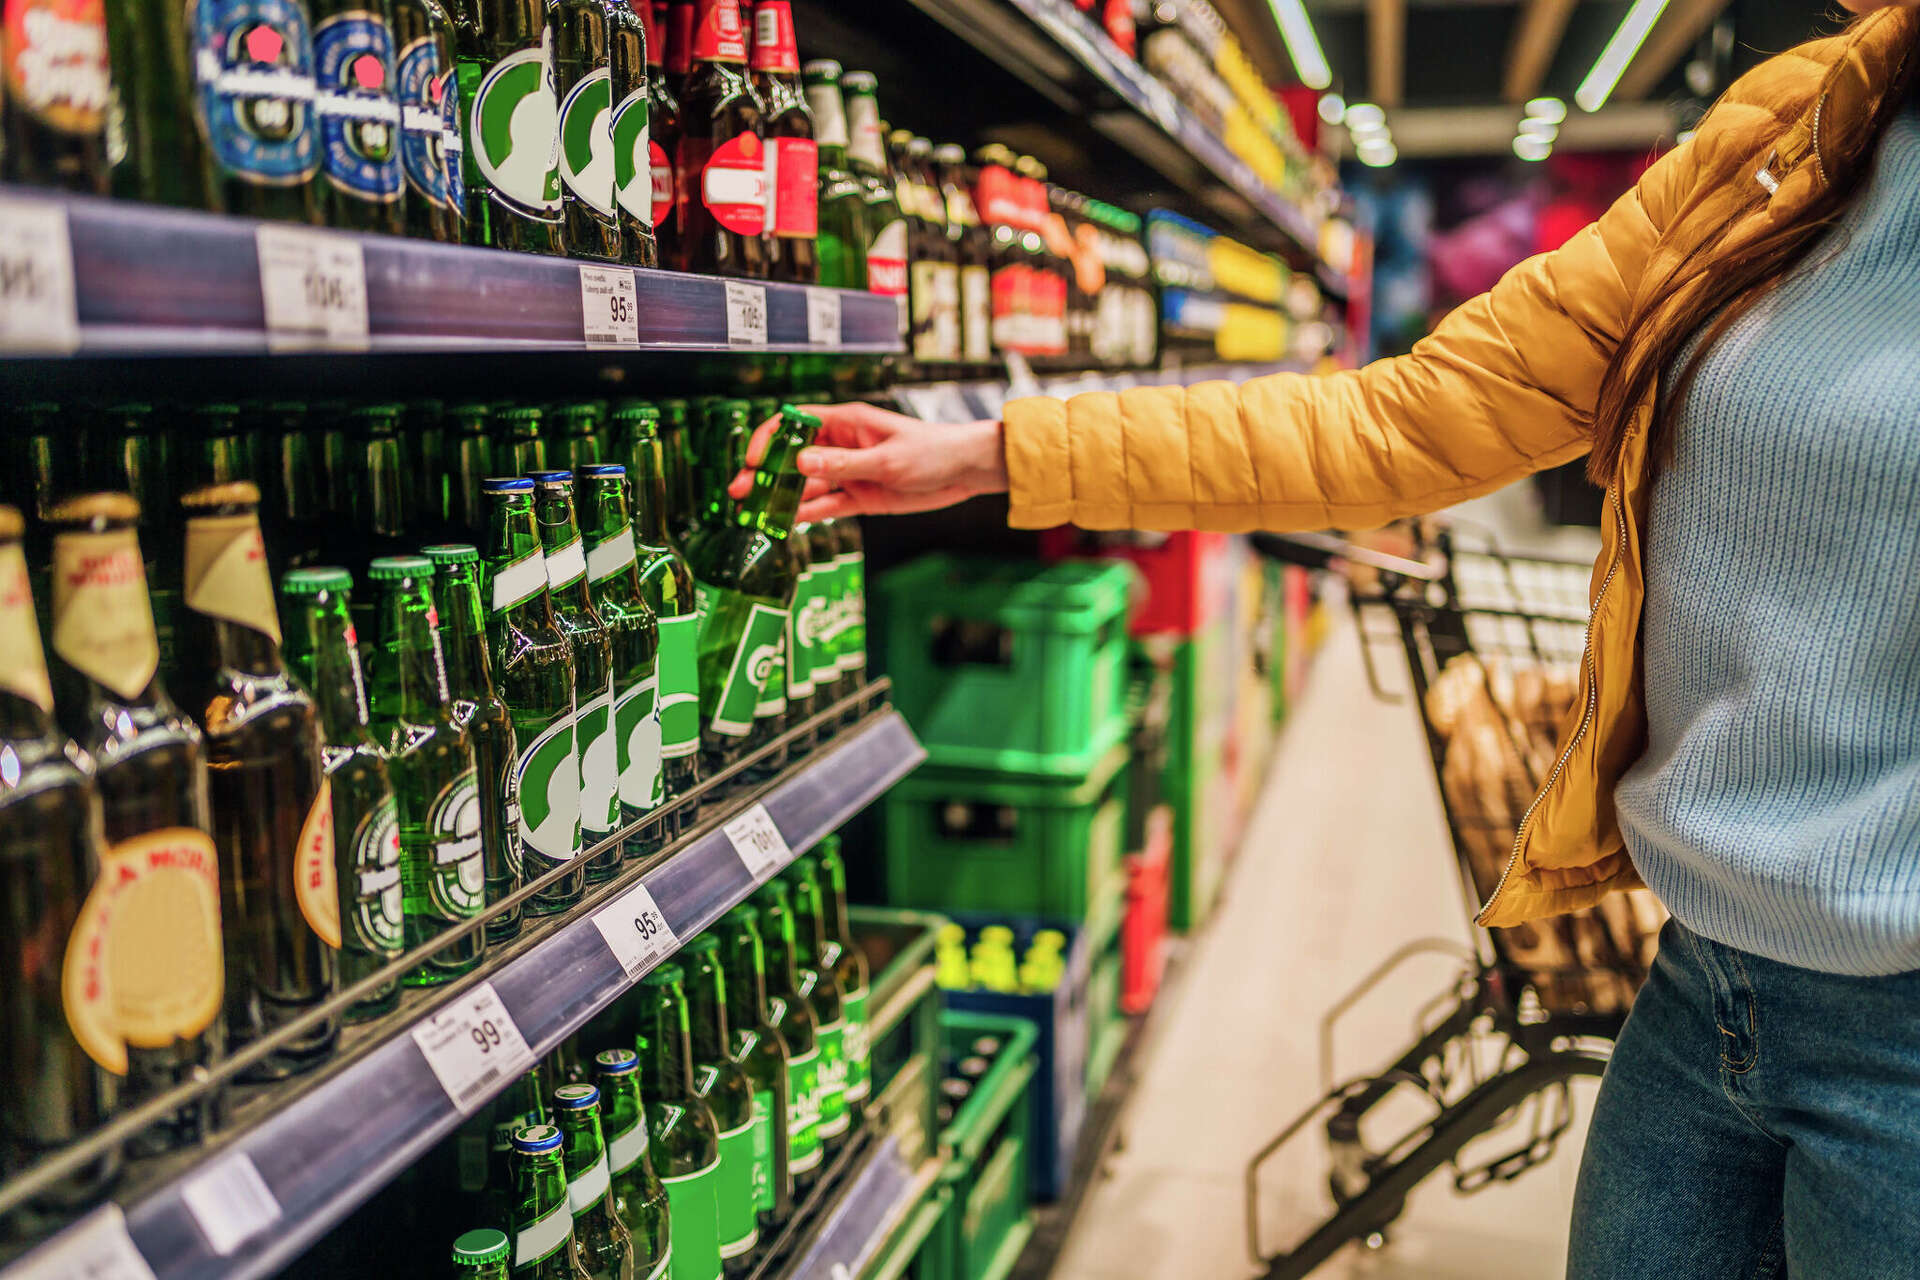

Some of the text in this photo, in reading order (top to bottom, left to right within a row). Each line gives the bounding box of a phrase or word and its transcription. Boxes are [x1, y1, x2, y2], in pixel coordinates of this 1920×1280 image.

[610, 295, 627, 322] 95
[634, 912, 657, 940] 95
[471, 1020, 501, 1054] 99
